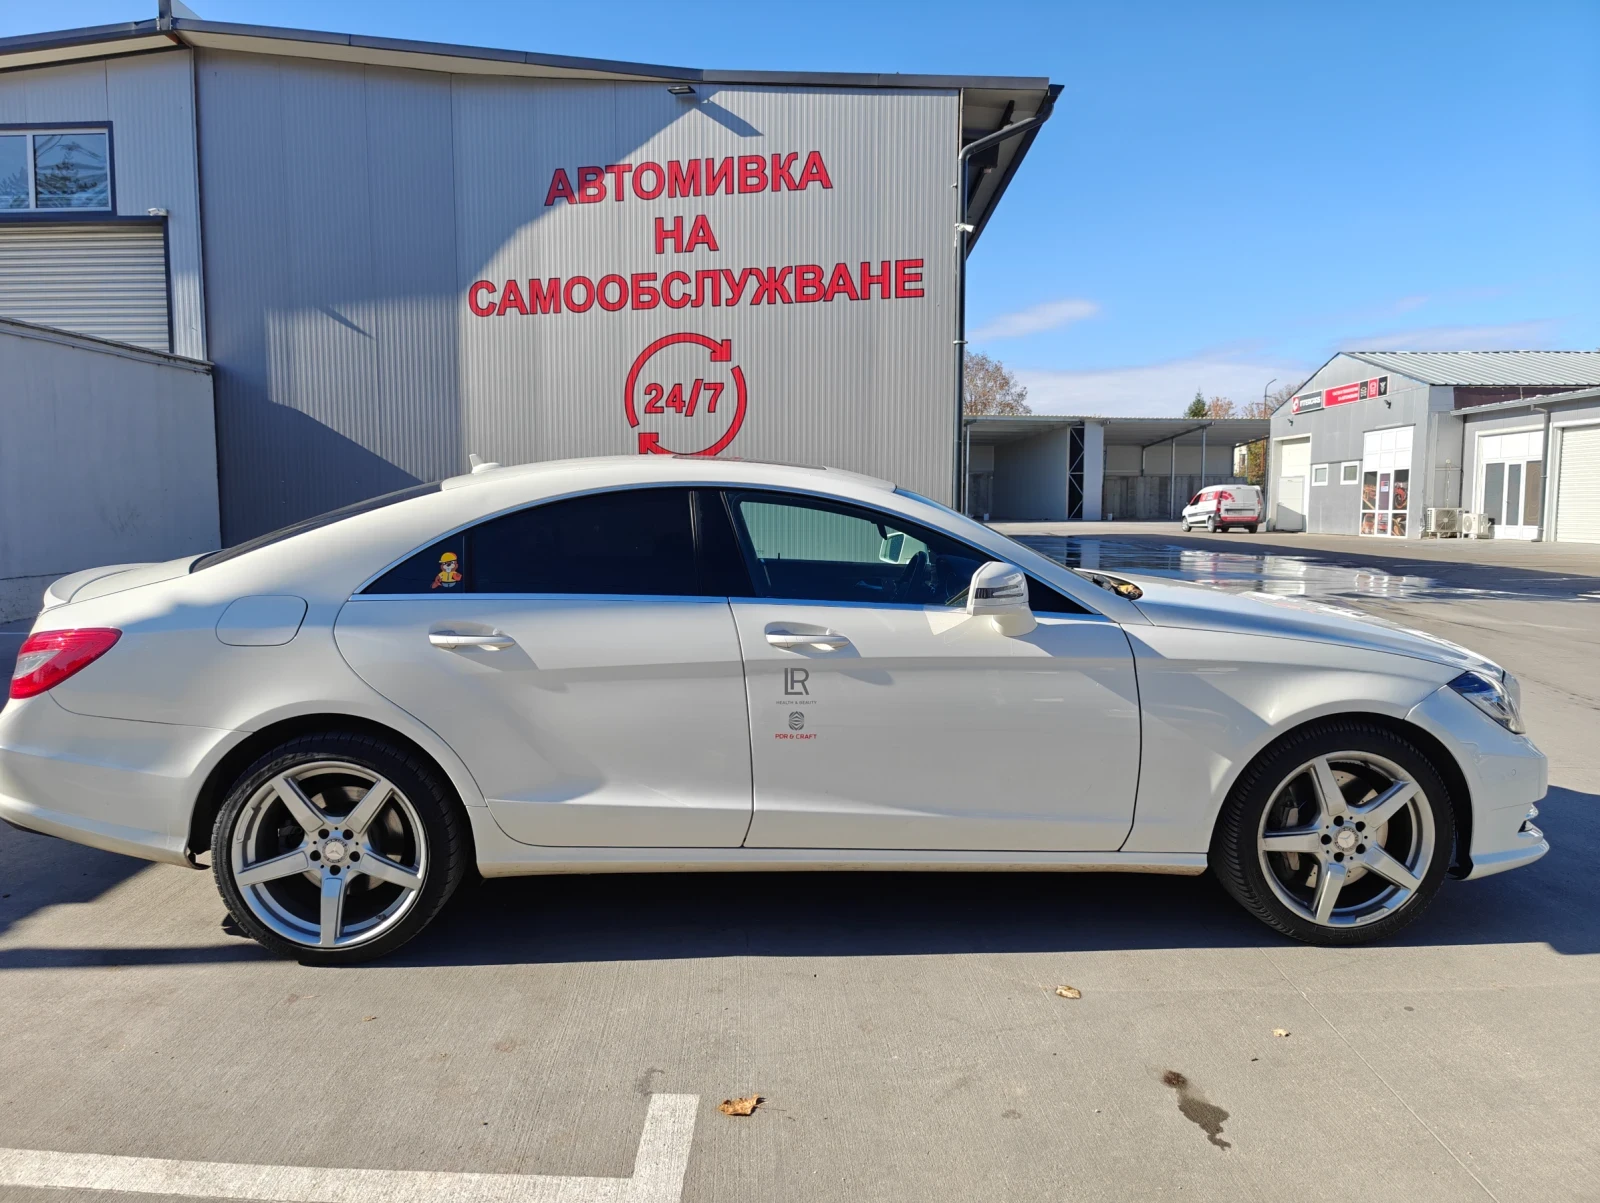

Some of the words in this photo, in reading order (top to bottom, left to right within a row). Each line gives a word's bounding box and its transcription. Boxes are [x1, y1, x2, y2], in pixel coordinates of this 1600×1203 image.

[544, 150, 833, 206] АВТОМИВКА
[654, 214, 720, 254] НА
[468, 258, 926, 317] САМООБСЛУЖВАНЕ
[644, 378, 725, 418] 24/7
[784, 668, 810, 695] LR
